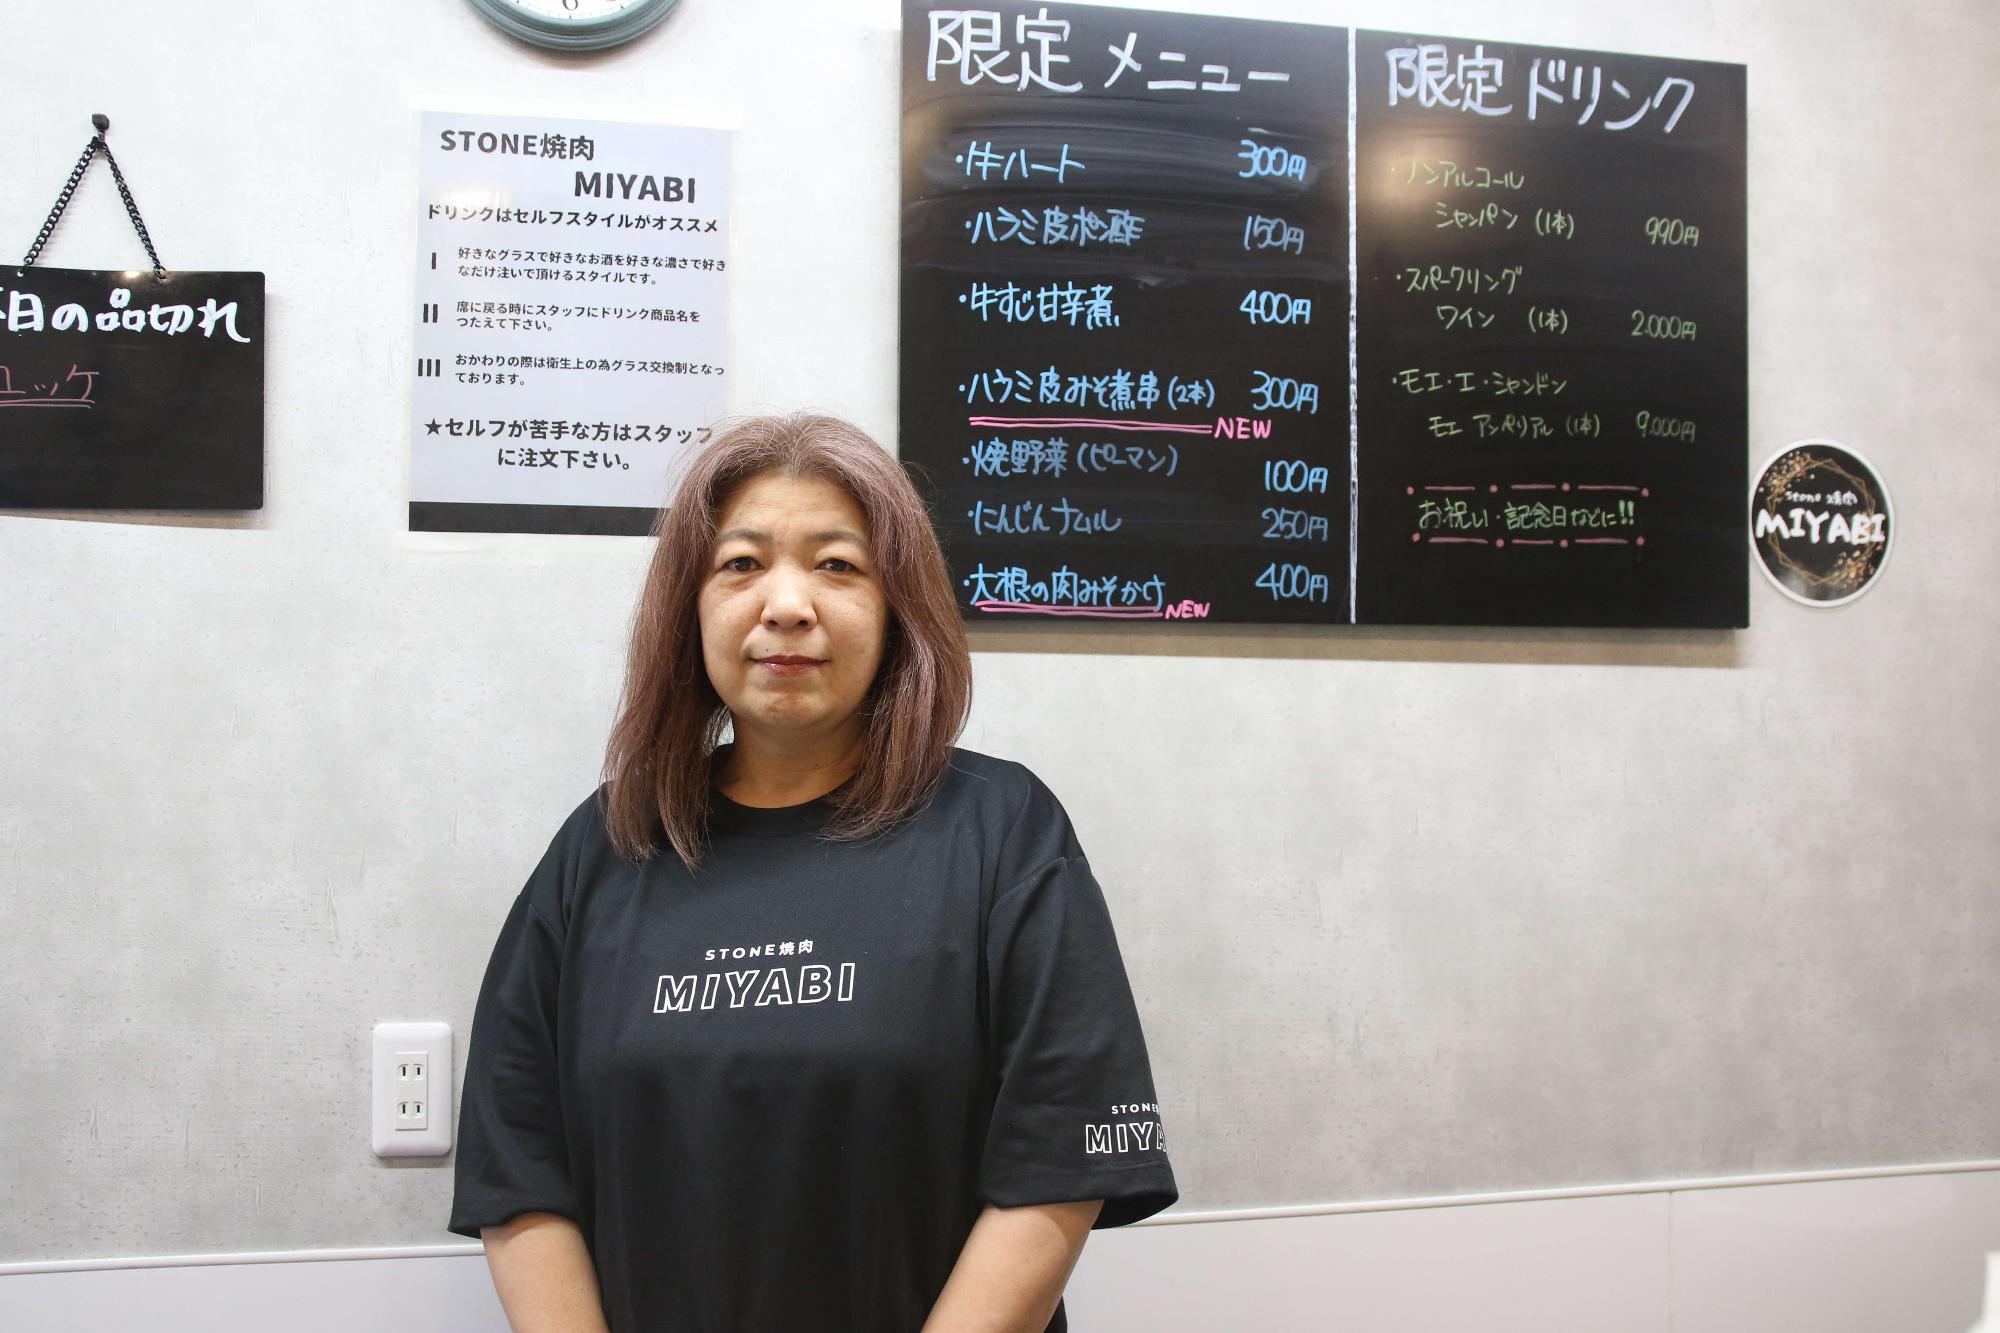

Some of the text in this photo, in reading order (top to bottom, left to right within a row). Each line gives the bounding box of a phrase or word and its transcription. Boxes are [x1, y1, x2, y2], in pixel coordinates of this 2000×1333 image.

[926, 8, 1291, 94] 限定 メニュー
[1385, 44, 1696, 134] 限定 ドリンク
[440, 130, 596, 162] STONE焼肉
[1238, 139, 1308, 181] 300円
[574, 170, 697, 204] MIYABI
[428, 204, 719, 234] ドリンクはセルフスタイルがオススメ
[1243, 215, 1305, 255] 150円
[1435, 202, 1519, 230] シャンパン
[1645, 216, 1700, 247] 990円
[458, 246, 726, 272] 好きなグラスで好きなお酒を好きな濃さで好き
[458, 264, 656, 286] なだけ注いで頂けるスタイルです。
[0, 287, 251, 344] 日の品切れ
[456, 300, 701, 323] 席に戻る時にスタッフにドリンク商品名を
[1240, 289, 1312, 325] 400円
[1436, 305, 1495, 330] ワイン
[456, 316, 553, 332] つたえて下さい。
[455, 353, 725, 377] おかわりの際は衛生上の為グラス交換制となっ
[455, 372, 526, 387] ております。
[1251, 369, 1319, 415] 300円
[1214, 417, 1272, 440] NEW
[1428, 415, 1464, 438] モエ
[497, 448, 631, 471] に注文下さい。
[1264, 460, 1329, 494] 100円
[1261, 507, 1329, 542] 250円
[1756, 508, 1886, 546] MIYABI
[1255, 562, 1329, 603] 400円
[1165, 599, 1211, 620] NEW
[704, 938, 814, 961] STONE焼肉
[653, 962, 856, 1014] MIYABI
